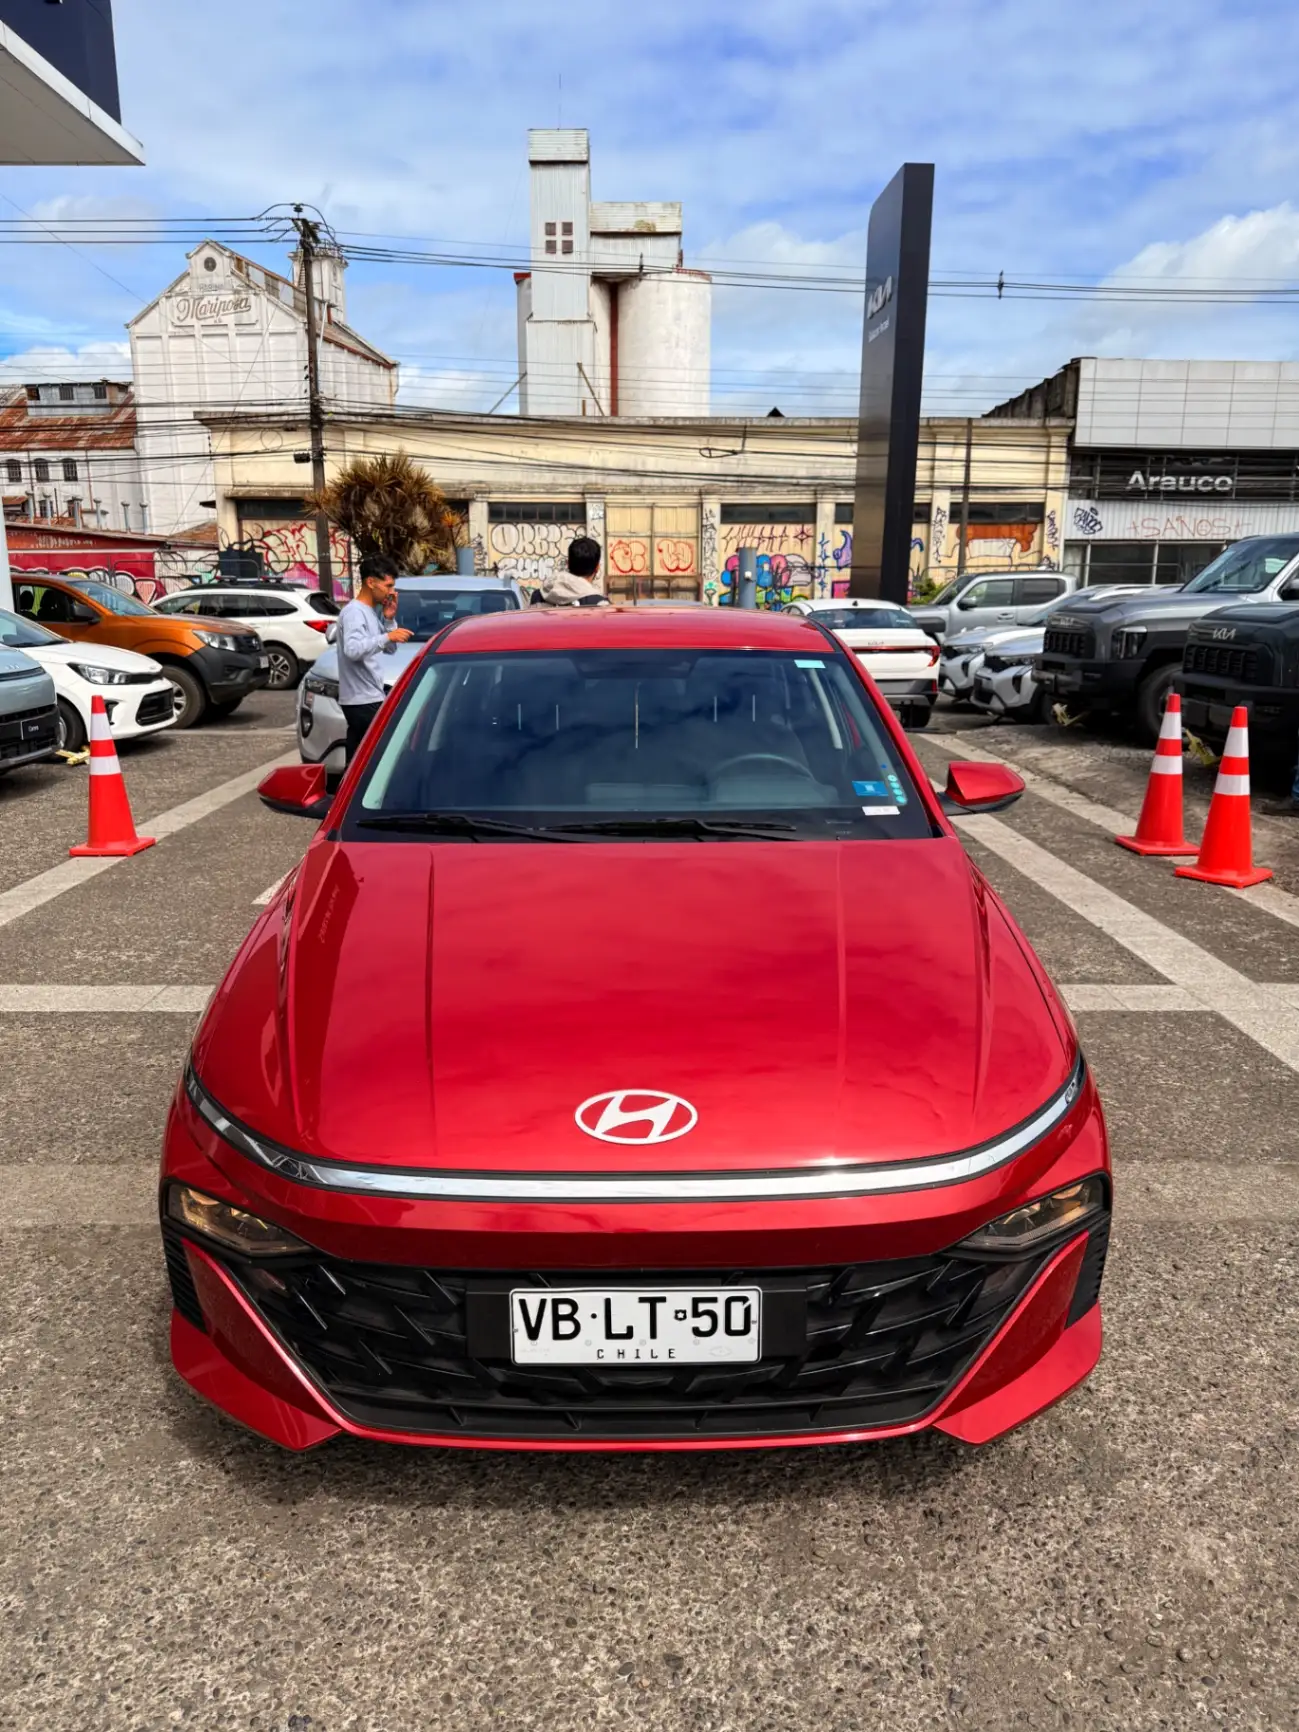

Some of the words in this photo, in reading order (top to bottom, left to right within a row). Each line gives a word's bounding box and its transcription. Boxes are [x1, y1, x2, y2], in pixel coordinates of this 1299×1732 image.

[176, 296, 251, 322] Mariposa
[1126, 470, 1233, 491] Arauco
[596, 1348, 677, 1359] CHILE
